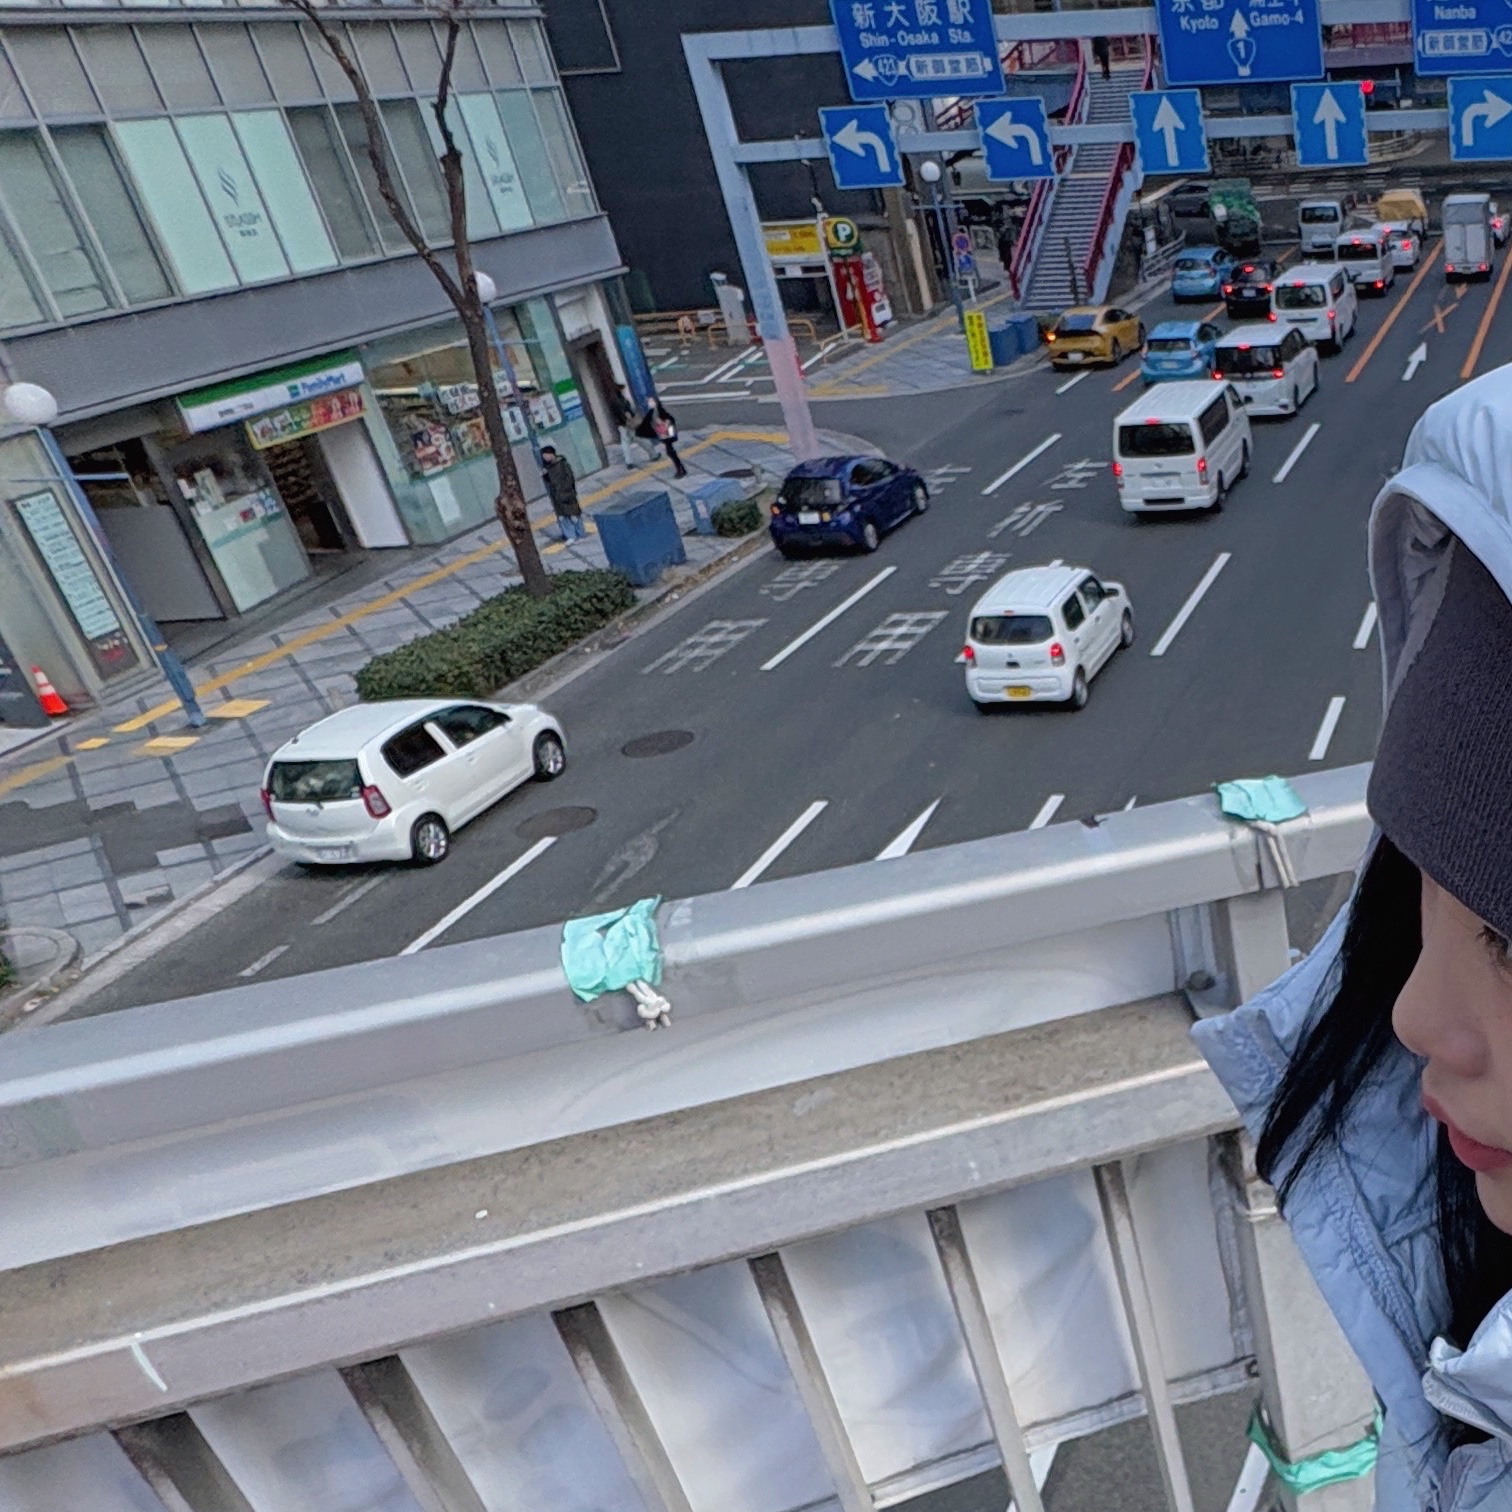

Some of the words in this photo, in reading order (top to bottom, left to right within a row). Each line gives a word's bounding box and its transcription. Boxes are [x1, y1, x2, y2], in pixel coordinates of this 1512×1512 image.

[852, 0, 975, 29] 新大阪駅
[1434, 5, 1477, 20] Nanba
[1180, 15, 1219, 34] Kyoto
[859, 29, 940, 48] Shin-Osaka
[1236, 41, 1246, 59] 1
[878, 58, 897, 75] 423
[837, 223, 851, 241] P
